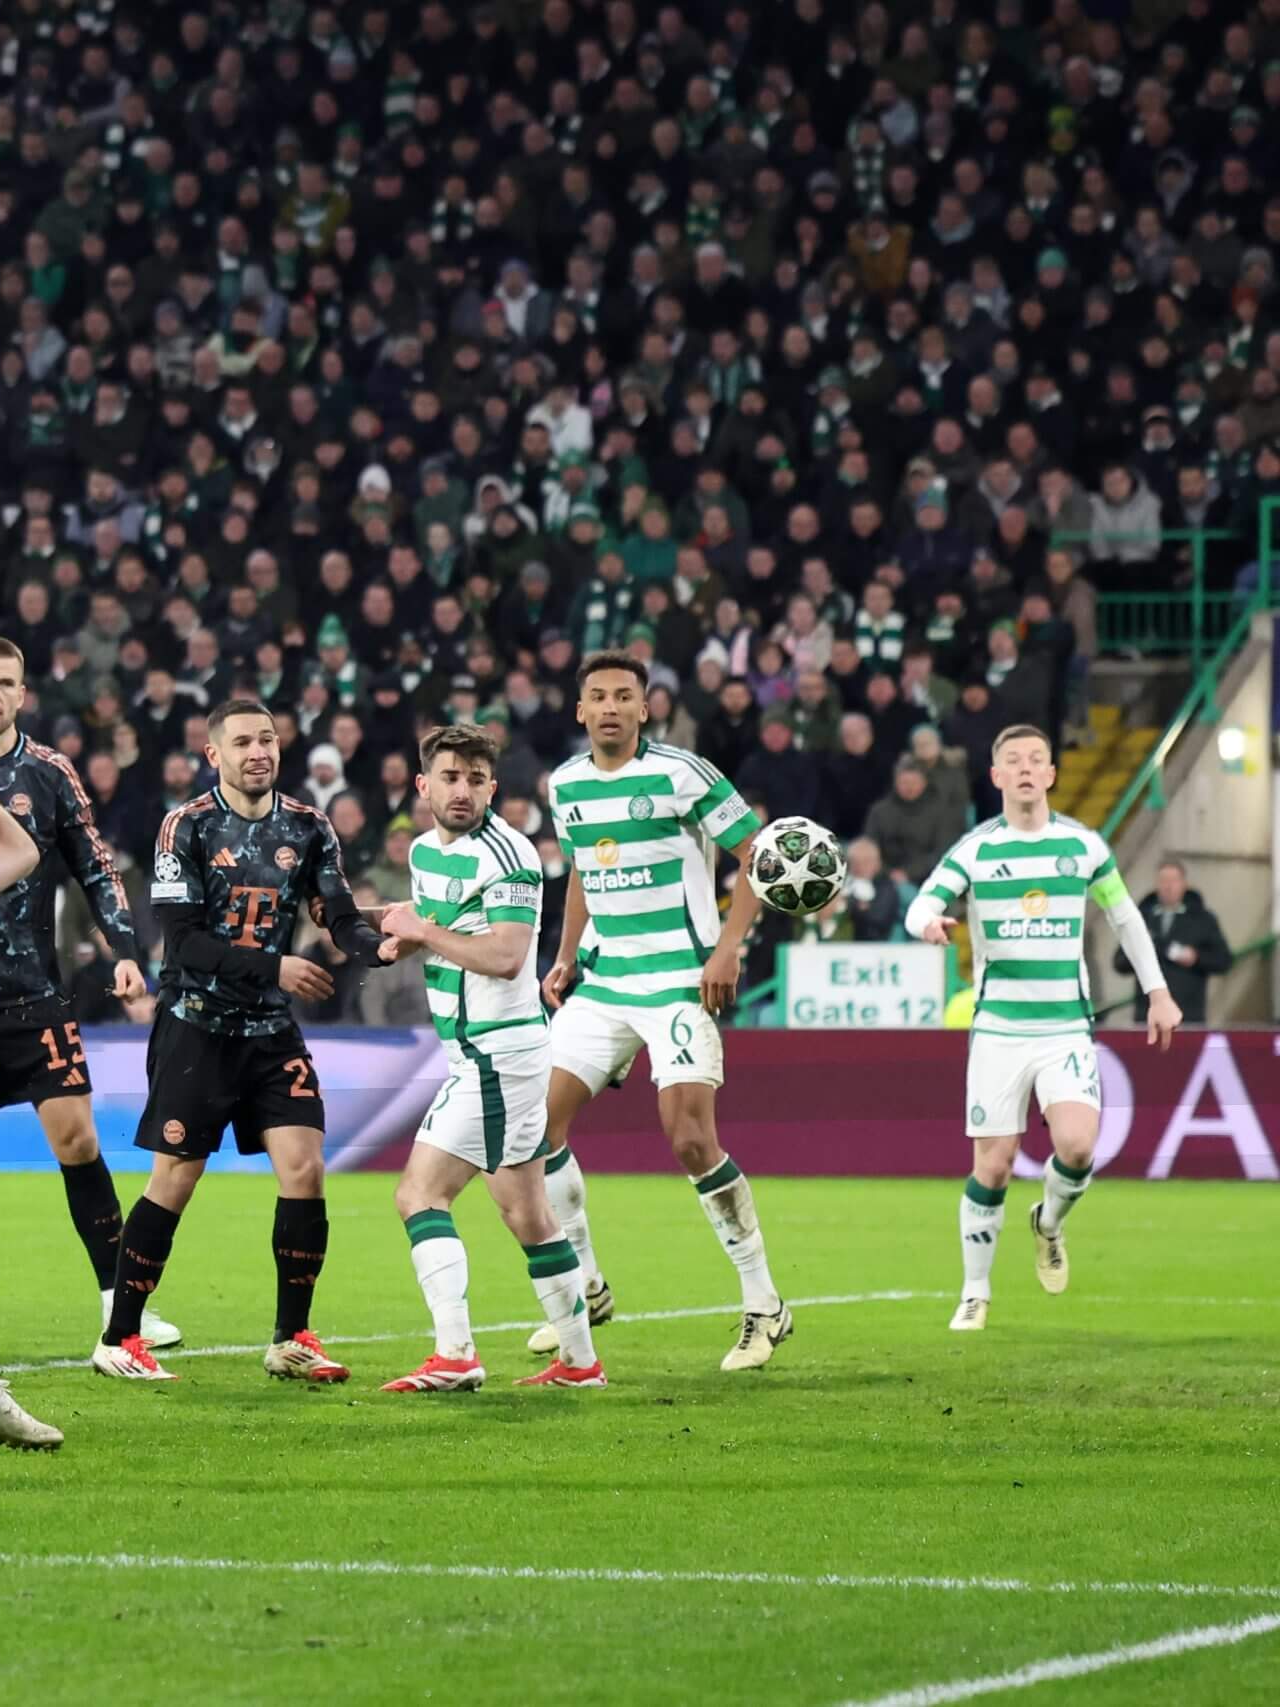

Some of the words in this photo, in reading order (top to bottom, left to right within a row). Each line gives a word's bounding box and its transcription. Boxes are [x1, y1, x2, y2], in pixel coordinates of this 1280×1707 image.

[582, 867, 653, 892] dafabet
[225, 886, 279, 948] T
[998, 919, 1071, 938] dafabet
[830, 960, 901, 986] Exit
[794, 997, 879, 1024] Gate
[898, 998, 936, 1024] 12
[671, 1009, 693, 1047] 6
[41, 1021, 86, 1070] 15
